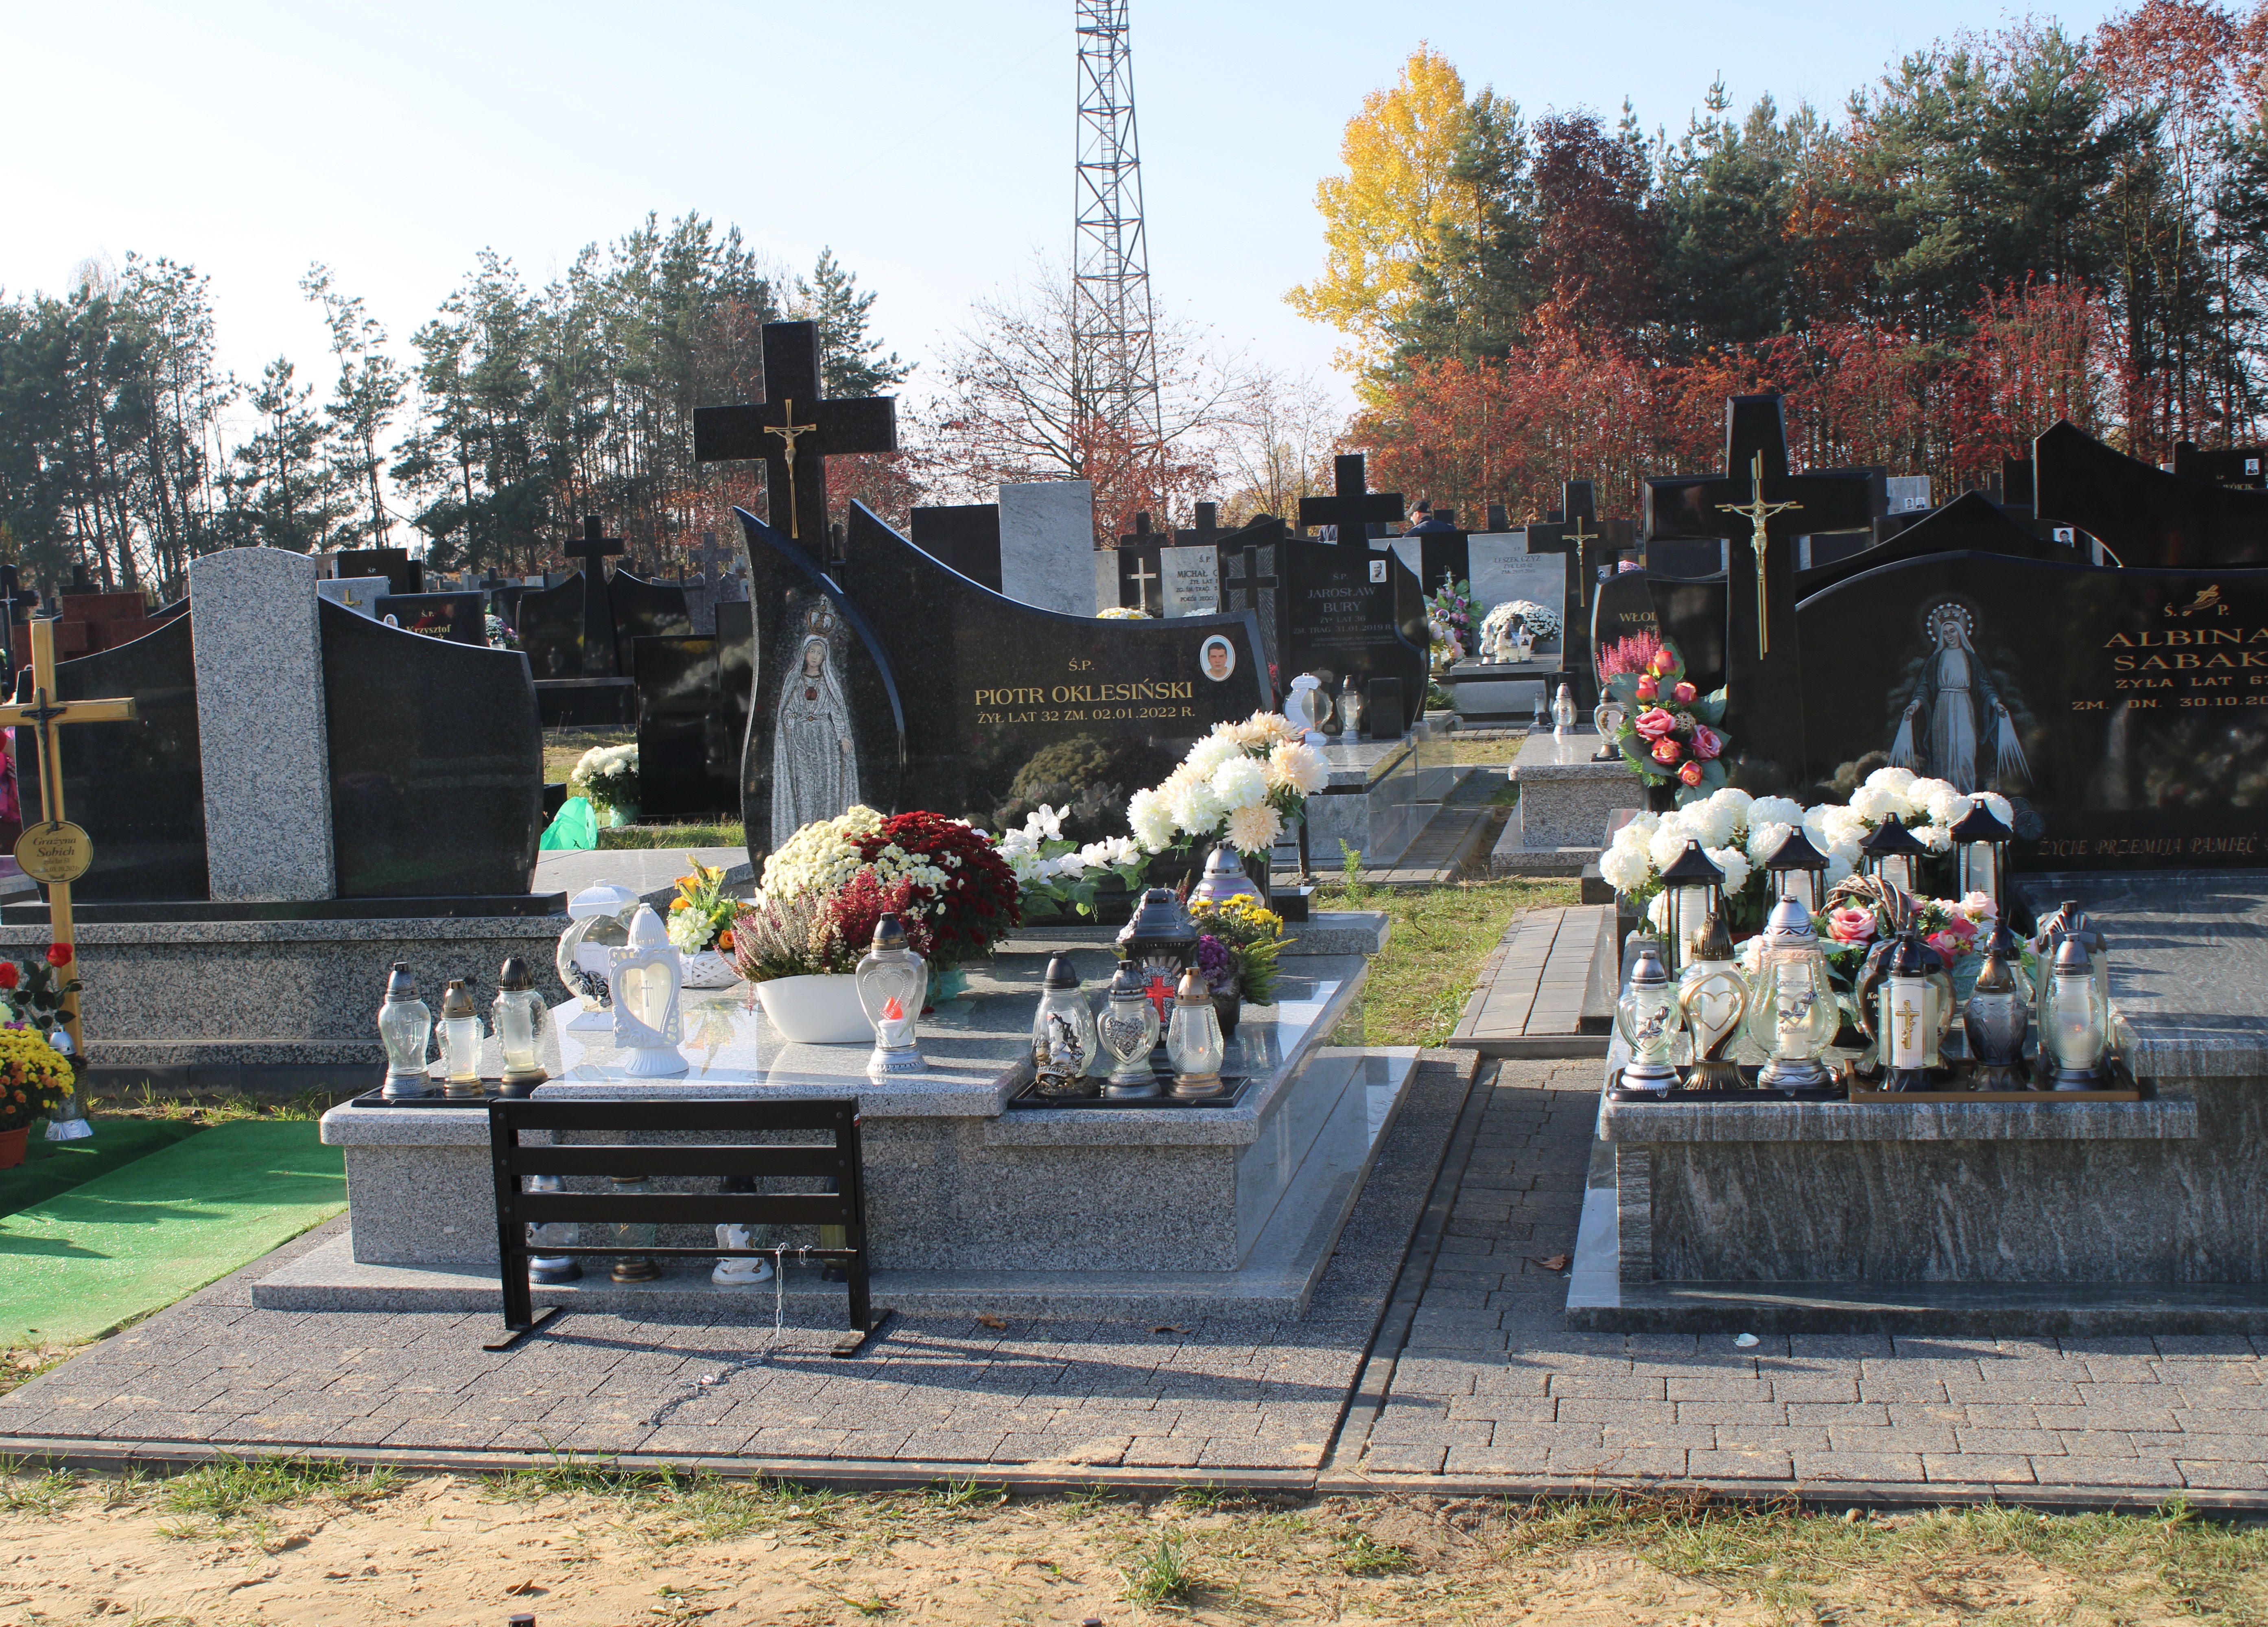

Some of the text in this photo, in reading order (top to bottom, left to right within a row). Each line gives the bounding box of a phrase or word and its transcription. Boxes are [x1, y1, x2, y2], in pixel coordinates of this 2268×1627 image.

[1177, 570, 1208, 578] MICHAŁ
[1307, 587, 1376, 598] JAROSŁAW
[1323, 601, 1361, 613] BURY
[406, 625, 452, 635] Krzysztof
[1335, 624, 1383, 632] 31.01.2019
[2102, 627, 2268, 648] ALBINA
[1068, 658, 1095, 671] Ś.P.
[2115, 677, 2174, 688] ŻYŁA
[2190, 676, 2233, 687] LAT
[975, 678, 1193, 705] PIOTR OKLESIŃSKI
[2072, 700, 2109, 710] ZM.
[2126, 699, 2162, 709] DN.
[977, 706, 1195, 724] ŻYŁ LAT 32 ZM. 02.01.2022 R.
[33, 837, 76, 846] Grażyna
[2037, 837, 2088, 856] ŻYCIE
[2095, 838, 2182, 857] PRZEMIJA
[2189, 832, 2258, 855] PAMIĘĆ
[37, 846, 74, 857] Sobich
